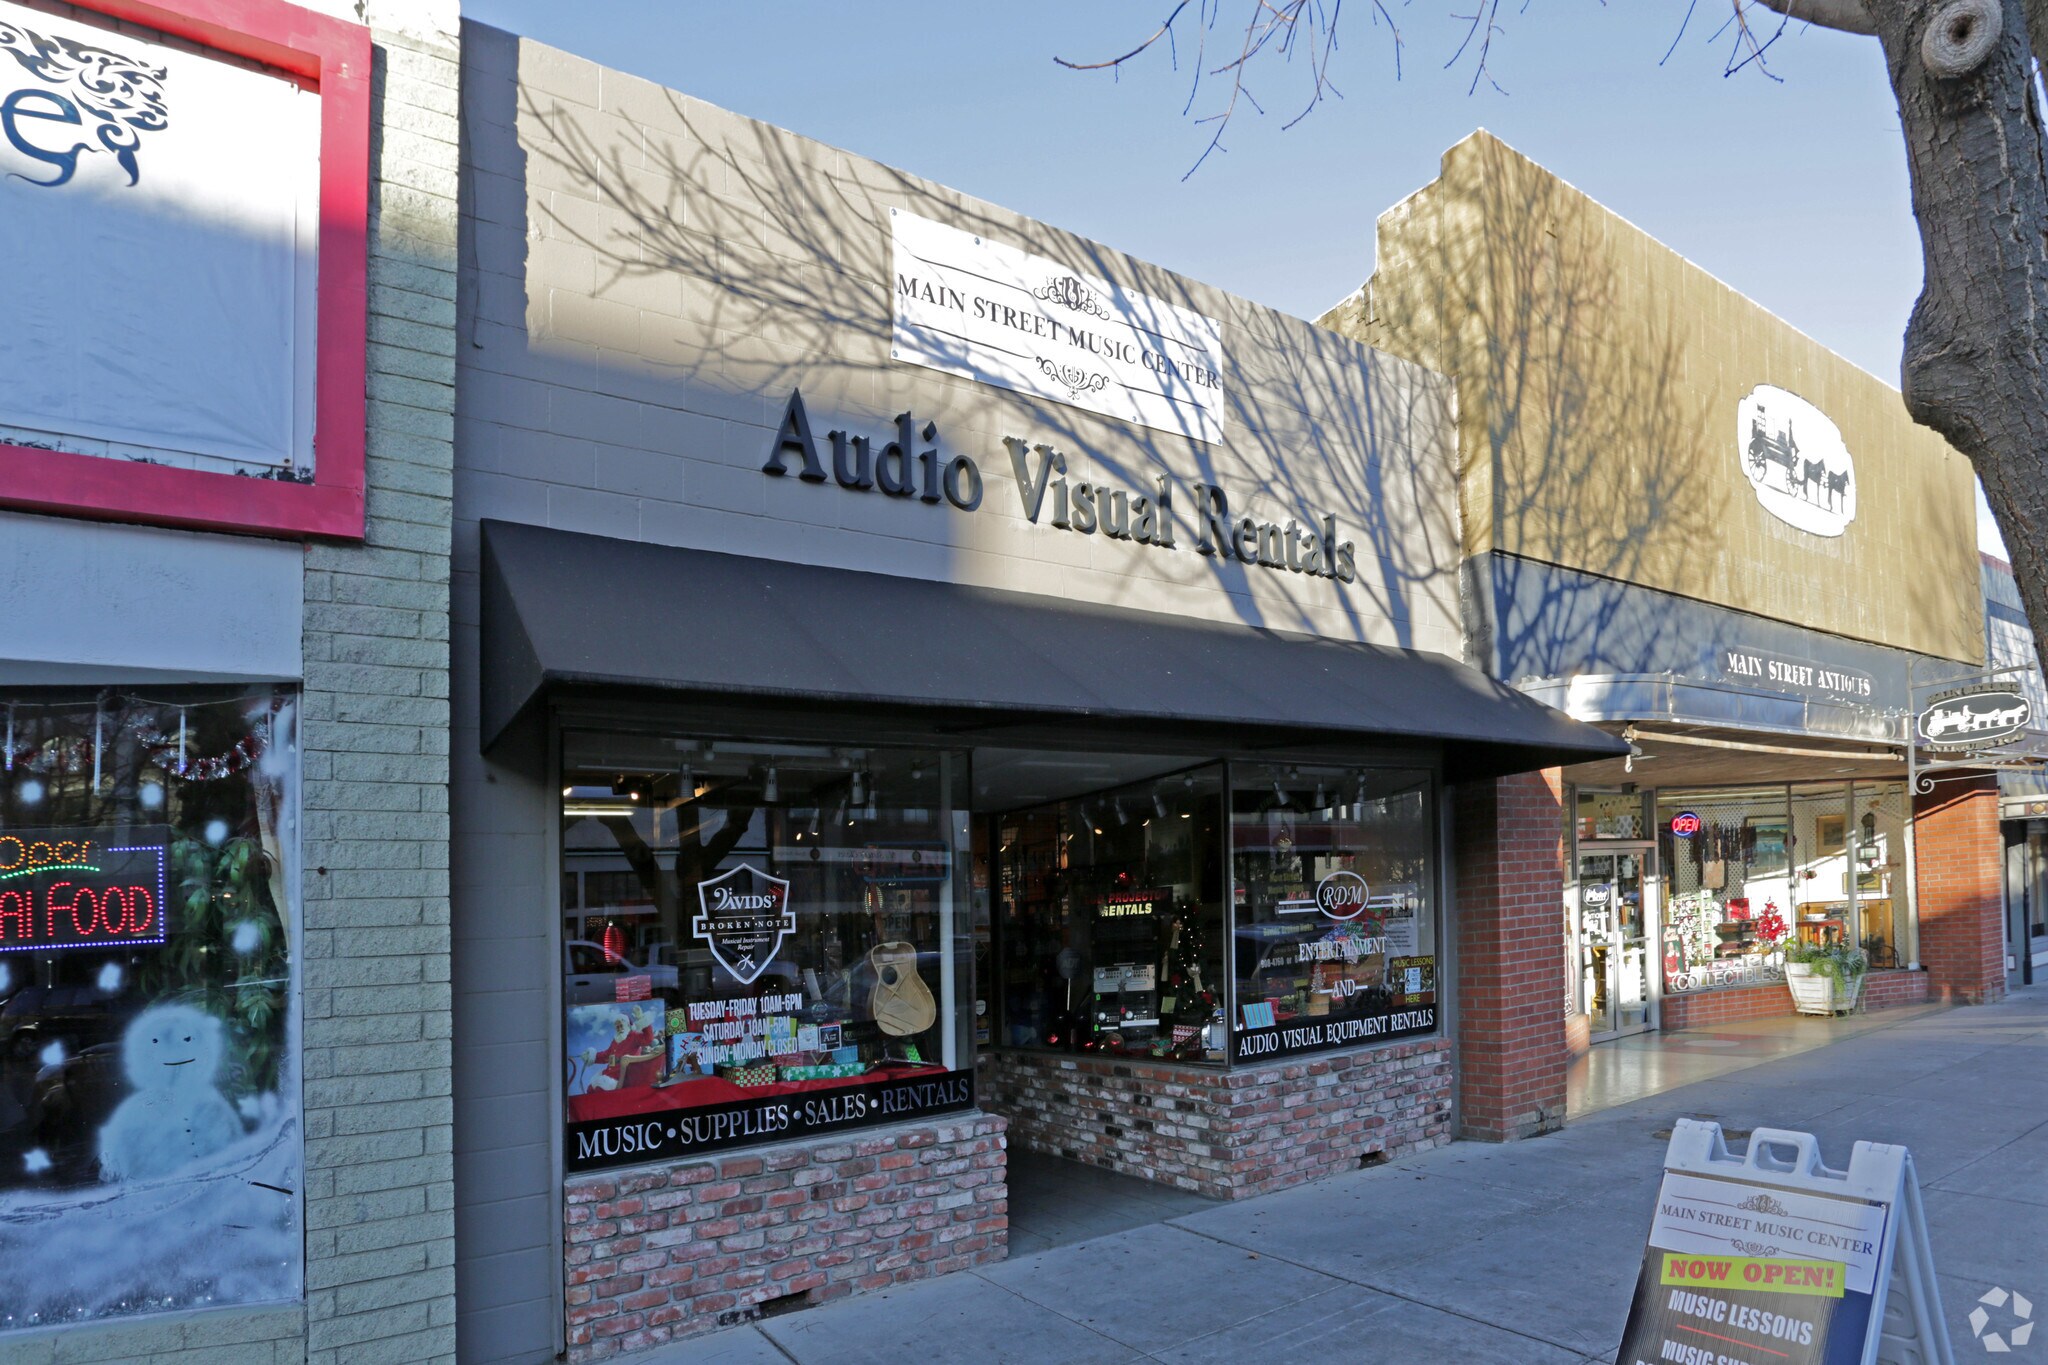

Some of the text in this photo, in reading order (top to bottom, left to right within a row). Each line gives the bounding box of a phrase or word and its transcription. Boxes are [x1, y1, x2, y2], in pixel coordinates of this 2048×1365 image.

[897, 273, 1220, 390] MAIN STREET MUSIC CENTER
[761, 386, 1356, 584] Audio Visual Rentals
[1727, 652, 1871, 697] MAIN STREET ANTIQUES
[1671, 817, 1700, 832] OPEN
[47, 882, 153, 936] FOOD
[1322, 886, 1363, 910] RDM
[700, 920, 789, 930] BROKEN NOTE
[721, 936, 770, 945] Musical Instrument
[1299, 937, 1387, 961] ENTERTAINMENT
[1393, 956, 1434, 967] MUSIC LESSONS
[1332, 979, 1356, 998] AND
[1677, 967, 1779, 990] COLLECTIBLES
[688, 993, 803, 1021] TUESDAY-FRIDAY 10AM-6PM
[1405, 993, 1422, 1003] HERE
[703, 1020, 746, 1042] SATURDAY
[1239, 1008, 1434, 1057] AUDIO VISUAL EQUIPMENT RENTALS
[697, 1041, 767, 1066] SUNDAY-MONDAY
[768, 1037, 798, 1057] CLOSED
[577, 1078, 969, 1160] MUSIC SUPPLIES SALES RENTALS
[1661, 1204, 1874, 1256] MAIN STREET MUSIC CENTER
[1668, 1259, 1835, 1289] NOW OPEN!
[1668, 1290, 1814, 1346] MUSIC LESSONS
[1660, 1339, 1714, 1365] MUSIC
